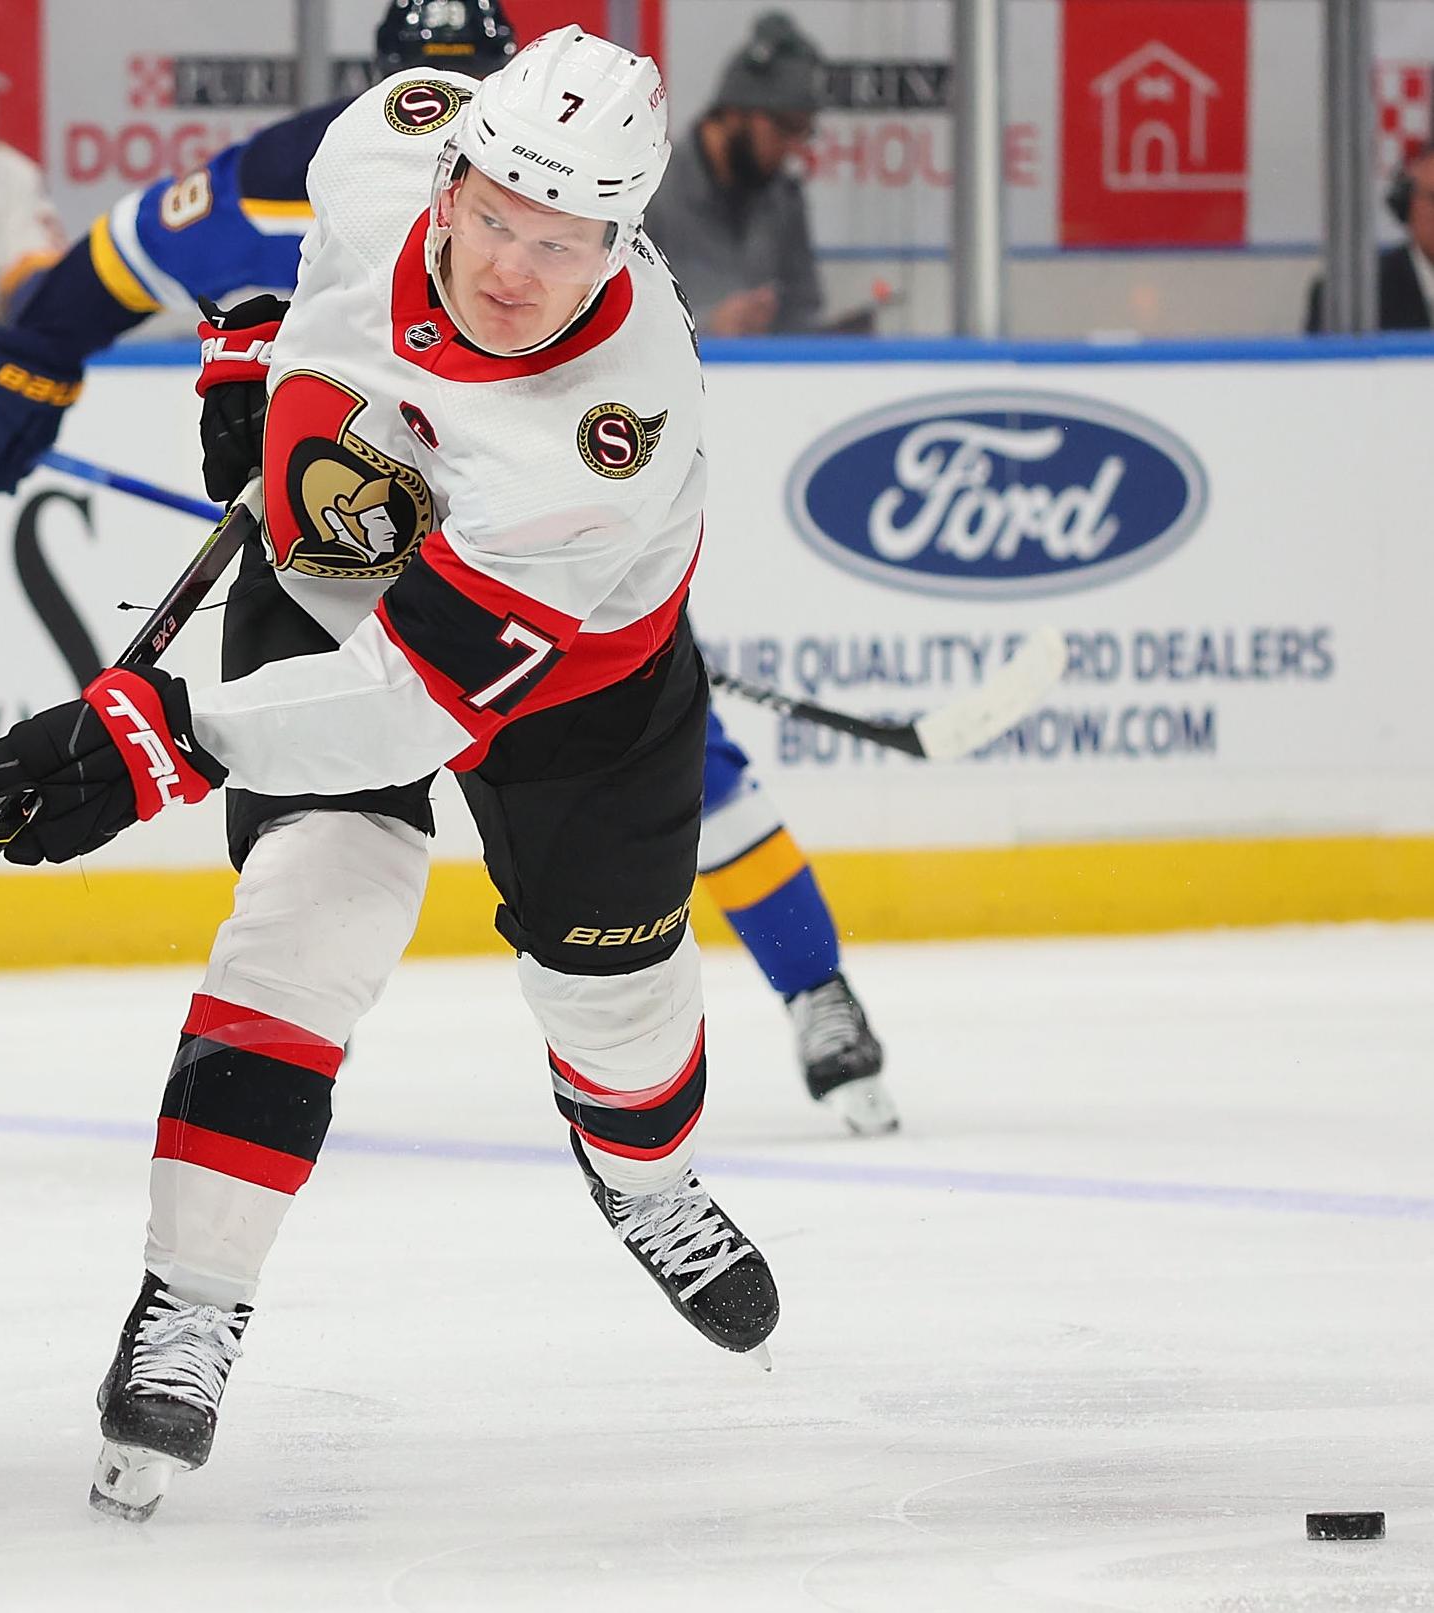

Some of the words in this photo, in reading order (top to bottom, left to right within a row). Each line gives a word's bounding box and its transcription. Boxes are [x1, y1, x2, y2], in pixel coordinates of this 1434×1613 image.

[557, 91, 585, 124] 7
[211, 315, 226, 329] 7
[598, 419, 632, 465] S
[868, 419, 1125, 561] Ford
[466, 617, 556, 710] 7
[794, 634, 993, 692] QUALITY
[1132, 624, 1335, 682] DEALERS
[105, 688, 185, 807] TRU
[173, 733, 193, 753] 7
